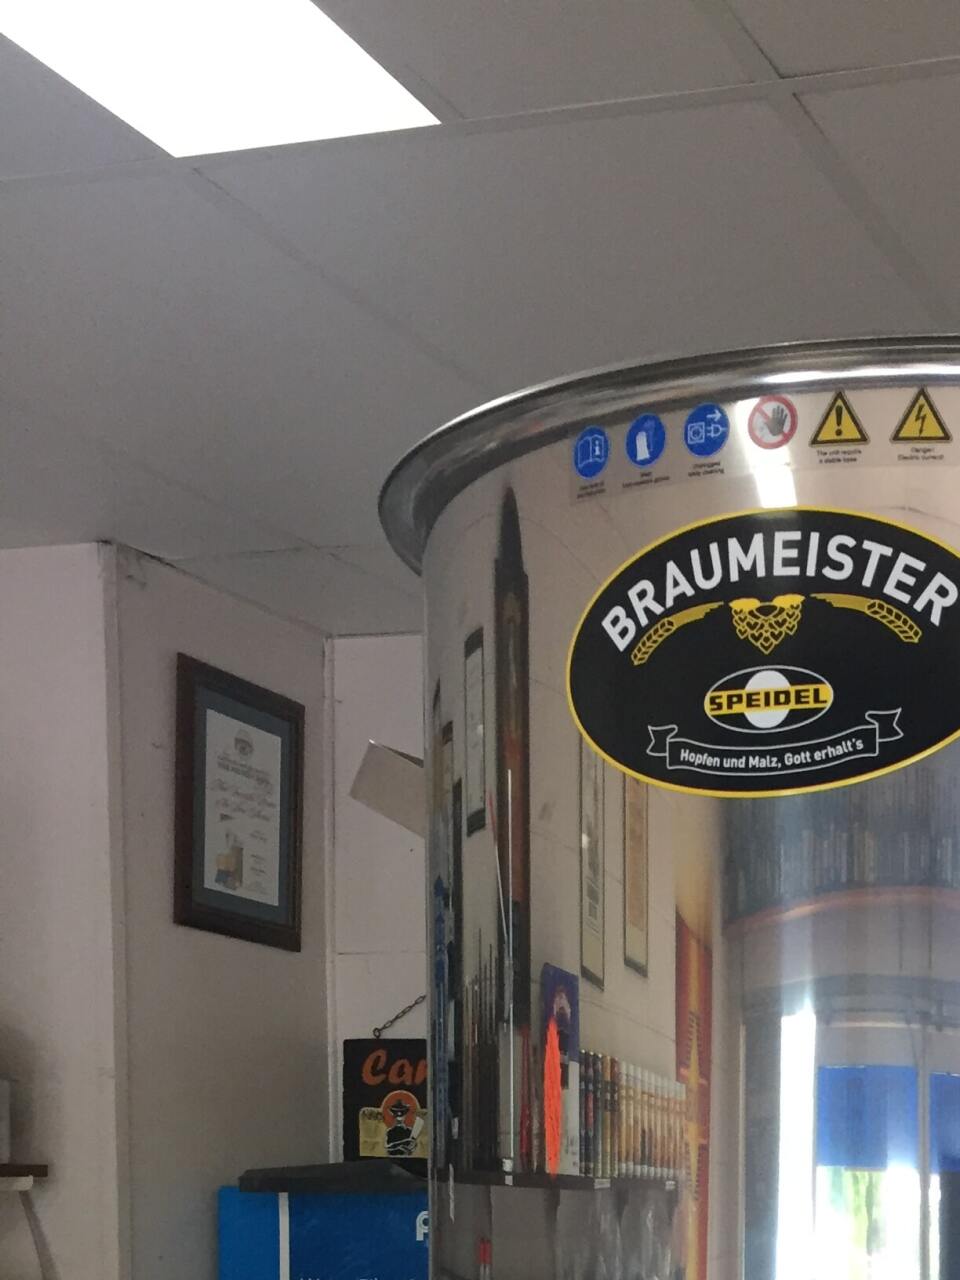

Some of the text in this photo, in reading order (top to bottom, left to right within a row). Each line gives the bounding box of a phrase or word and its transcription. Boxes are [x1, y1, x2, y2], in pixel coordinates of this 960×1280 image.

[601, 530, 959, 652] BRAUMEISTER
[709, 688, 828, 712] SPEIDEL
[680, 738, 864, 769] Hopfen und Malz, Gott erhalt's
